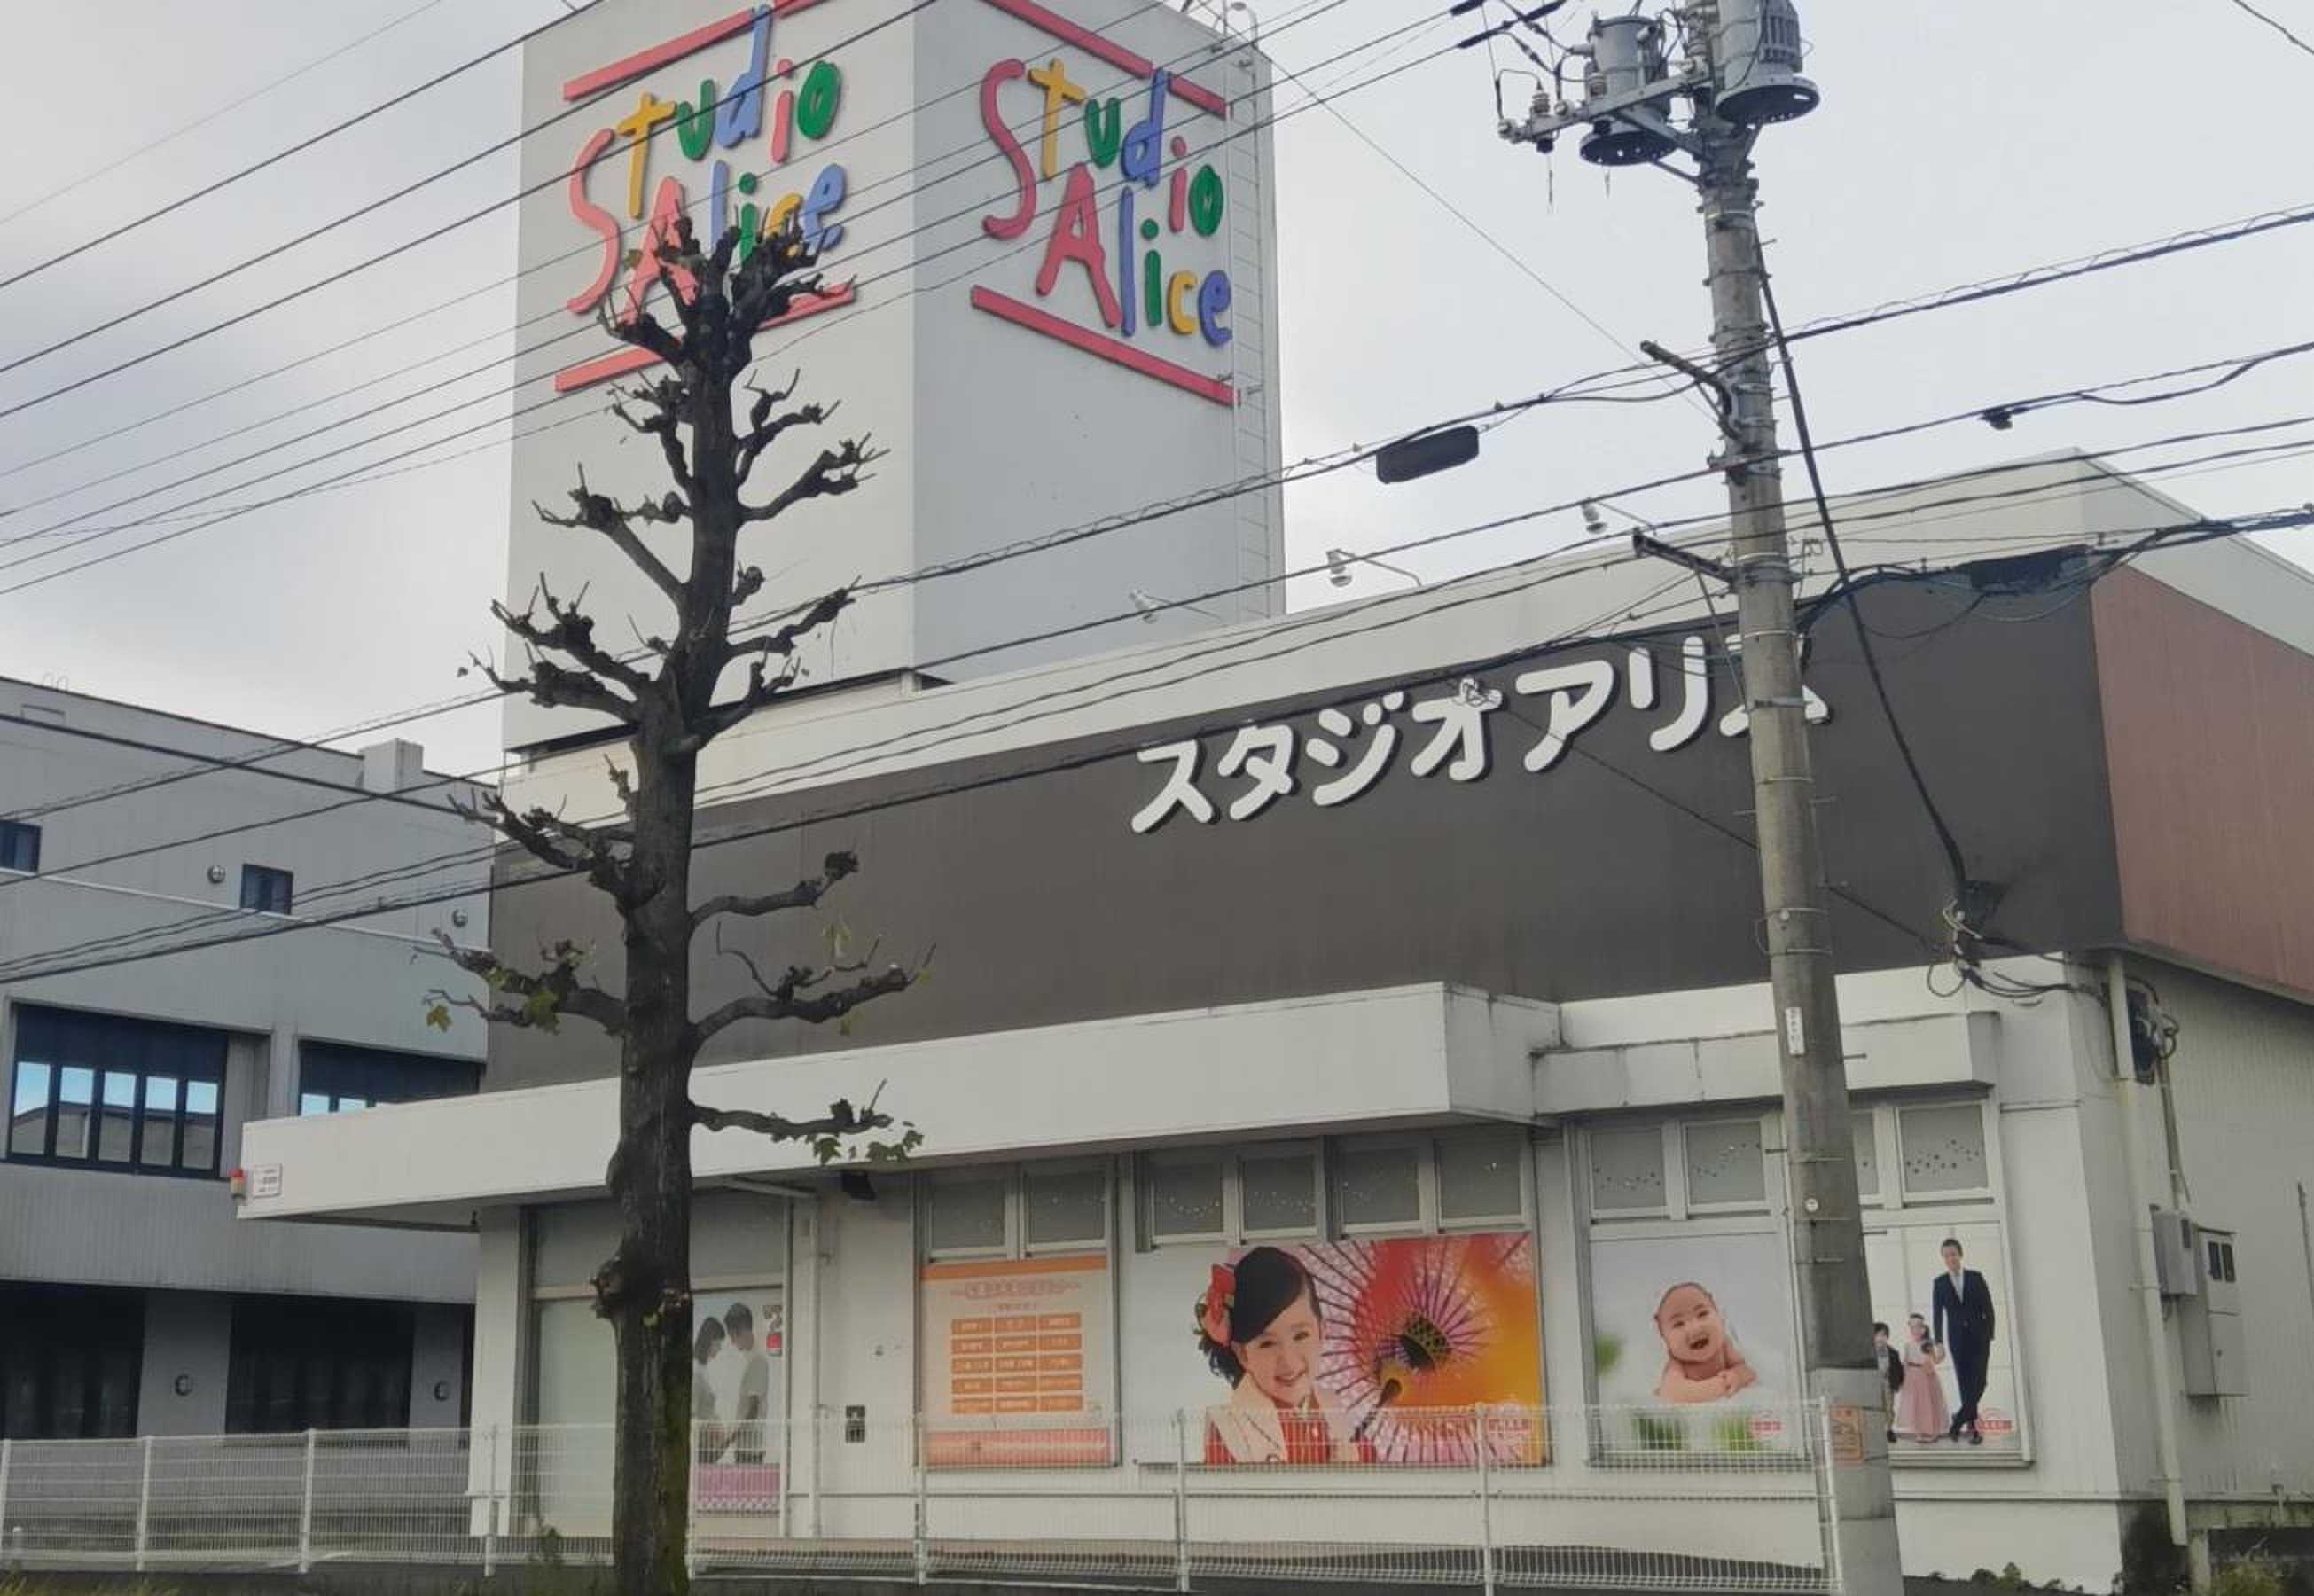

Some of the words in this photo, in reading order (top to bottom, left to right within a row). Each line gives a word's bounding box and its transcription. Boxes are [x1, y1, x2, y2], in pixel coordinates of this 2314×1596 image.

[567, 4, 842, 314] Studio
[981, 59, 1225, 240] Studio
[1036, 162, 1234, 346] Alice
